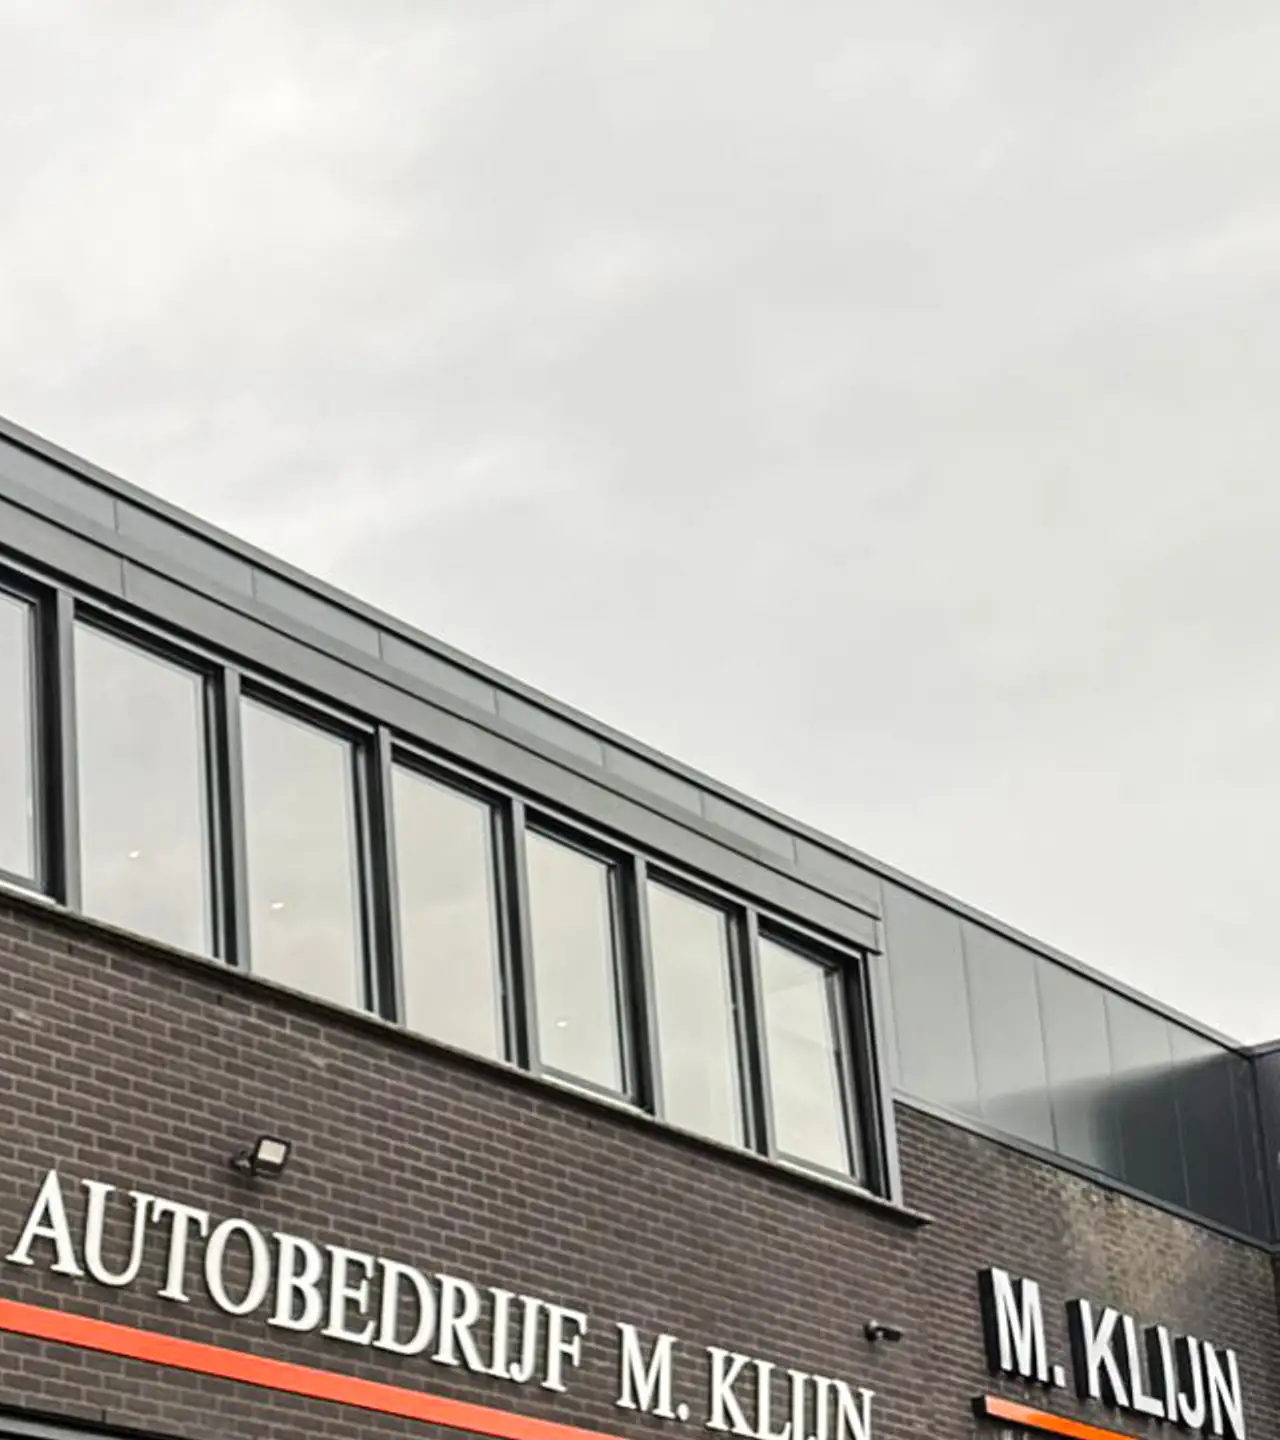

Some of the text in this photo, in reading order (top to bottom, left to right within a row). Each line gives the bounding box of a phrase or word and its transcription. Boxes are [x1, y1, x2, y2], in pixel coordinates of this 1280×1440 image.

[5, 1168, 588, 1393] AUTOBEDRIJF
[615, 1321, 690, 1422] M.
[980, 1266, 1067, 1389] M.
